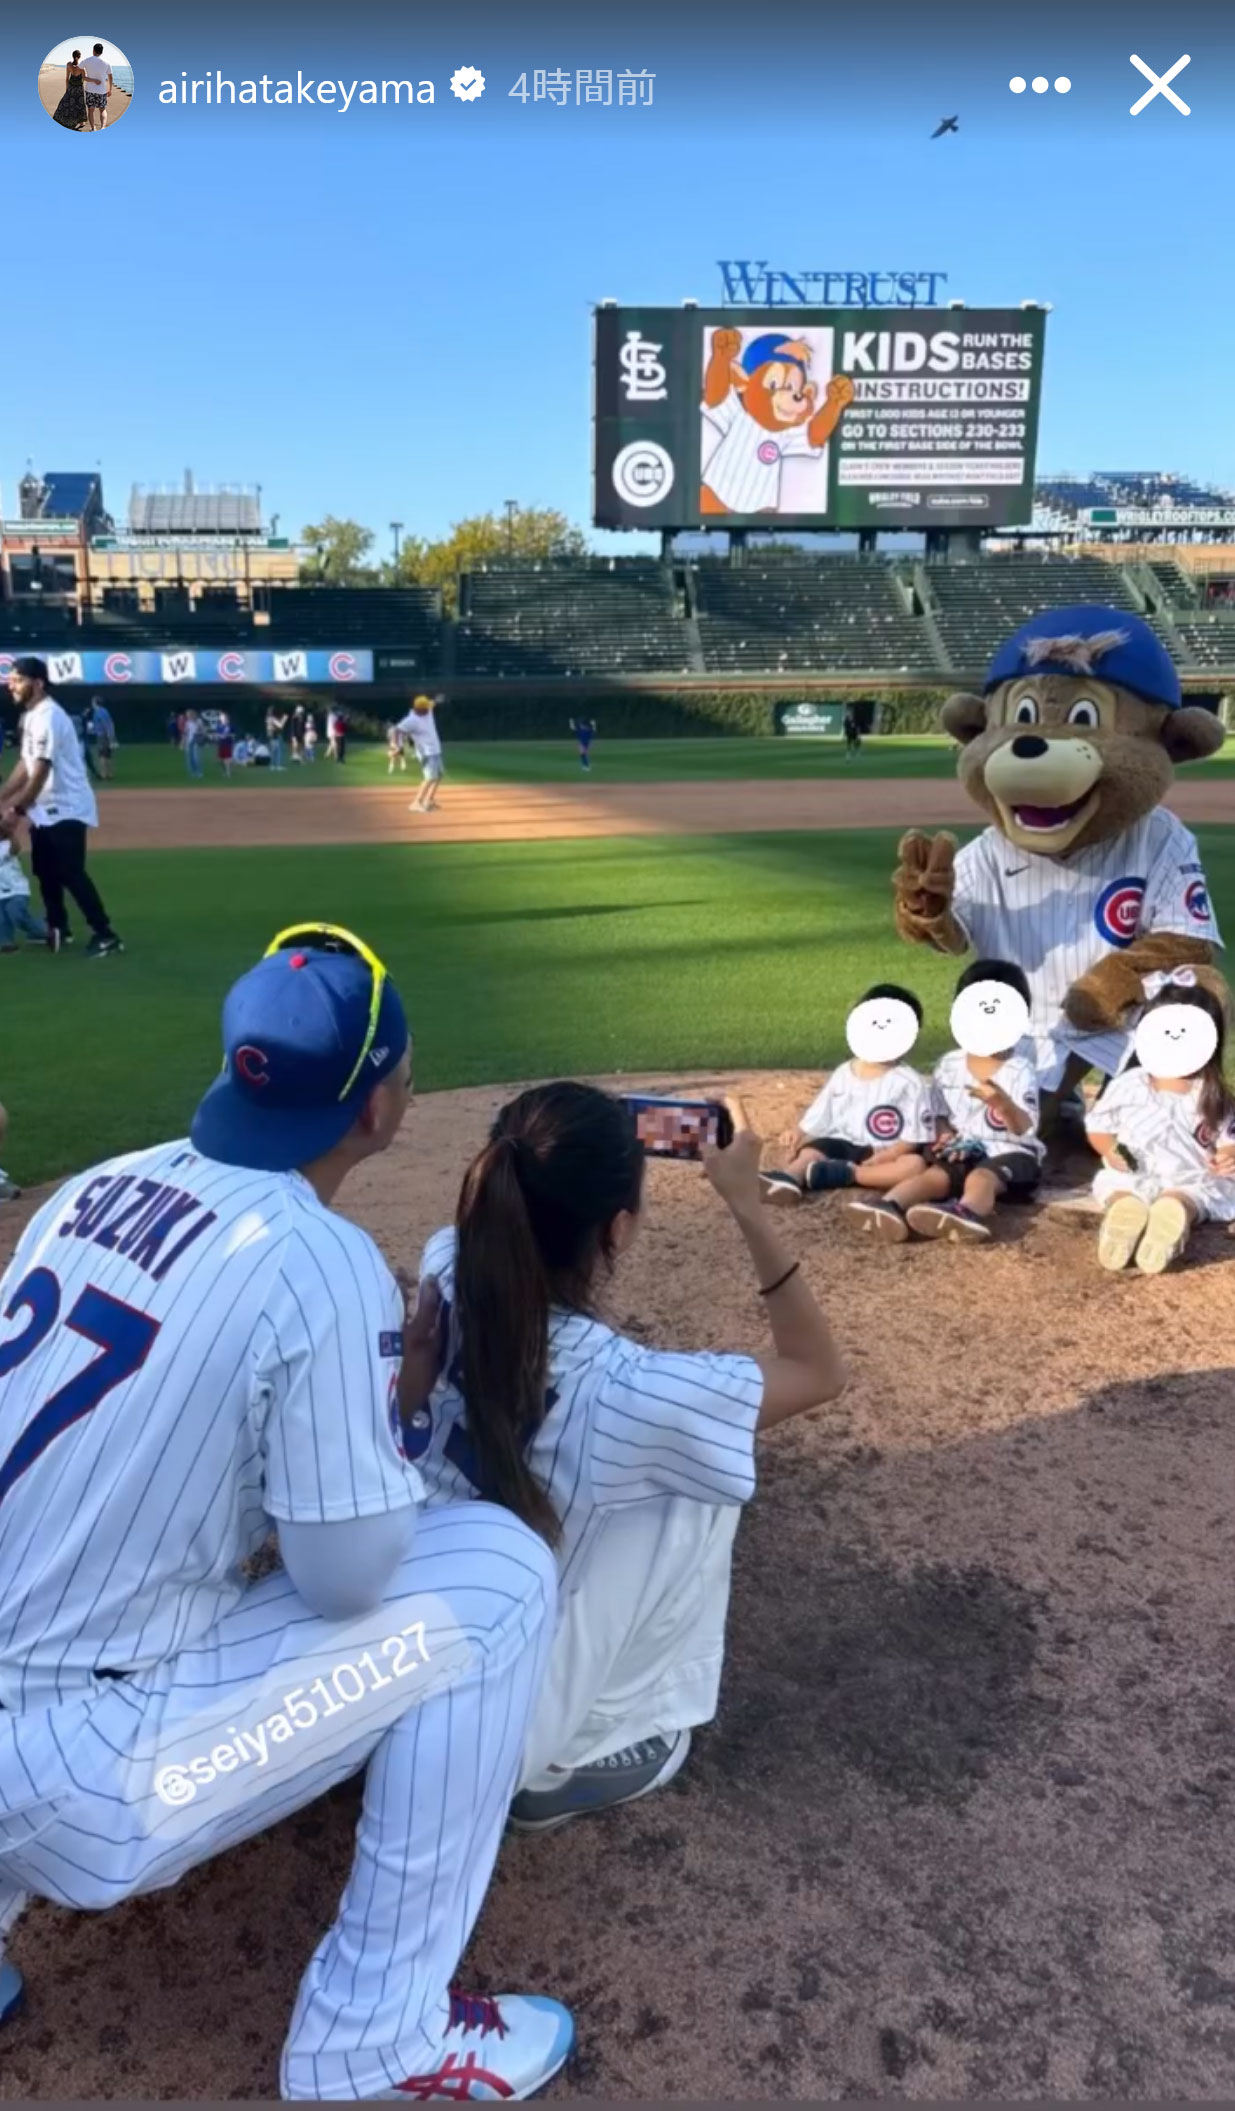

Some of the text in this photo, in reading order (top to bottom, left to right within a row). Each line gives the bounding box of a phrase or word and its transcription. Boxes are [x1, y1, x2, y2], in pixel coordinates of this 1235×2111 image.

[963, 333, 1034, 348] RUN THE
[842, 331, 960, 372] KIDS
[961, 352, 1032, 370] BASES
[856, 382, 1024, 398] INSTRUCTIONS!
[928, 409, 948, 419] AGE
[842, 424, 1026, 438] GO TO SECTIONS 230-233
[858, 441, 878, 450] THE
[959, 441, 973, 450] OF
[974, 441, 994, 450] THE
[56, 652, 356, 682] W C W C W C
[236, 1045, 270, 1086] C
[59, 1175, 217, 1282] SUZUKI
[0, 1266, 162, 1507] 27
